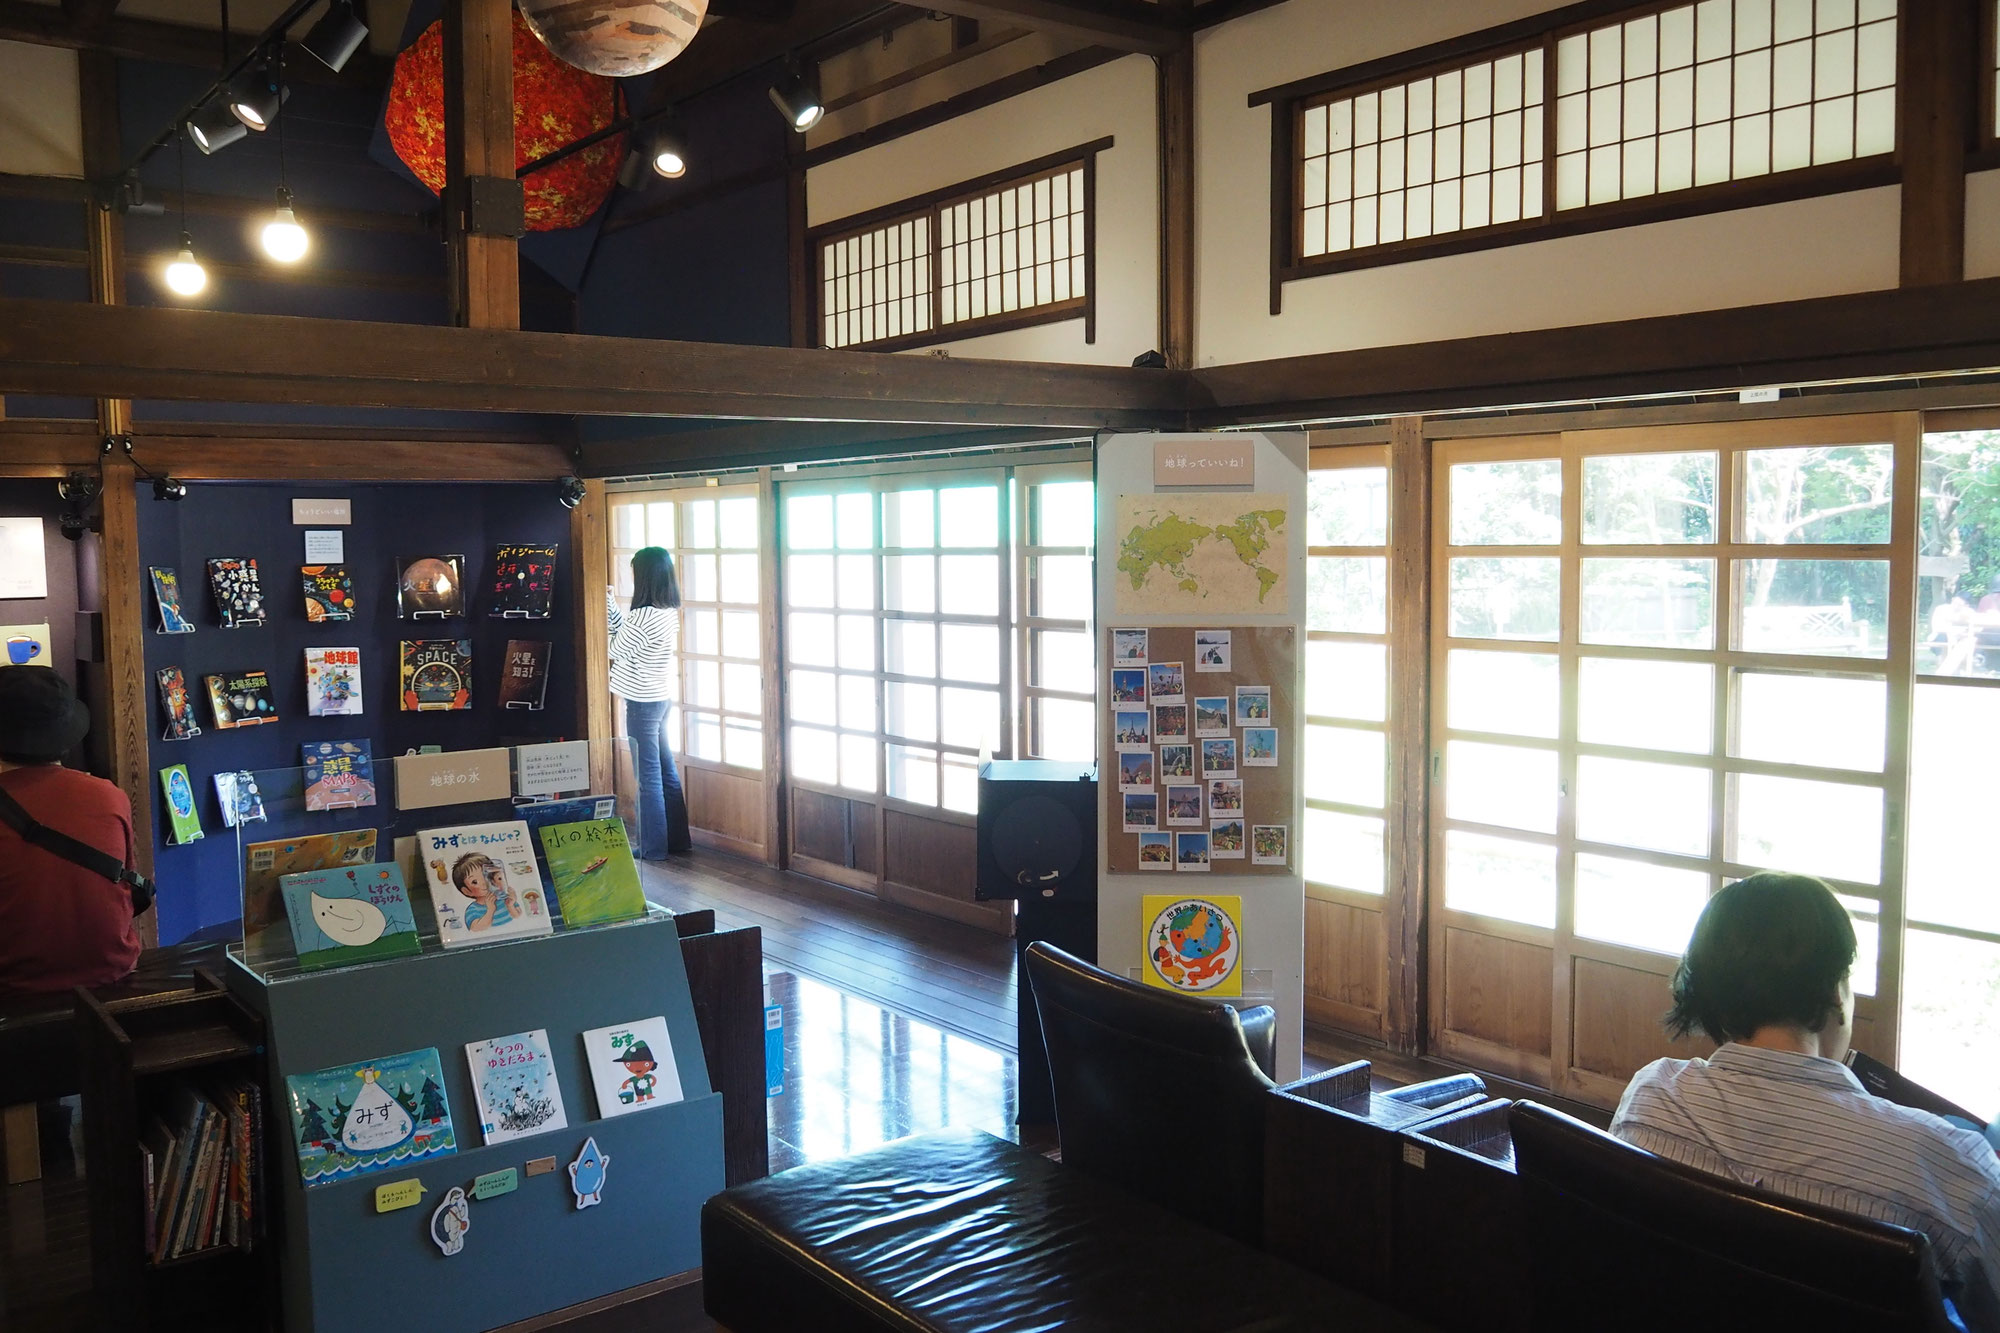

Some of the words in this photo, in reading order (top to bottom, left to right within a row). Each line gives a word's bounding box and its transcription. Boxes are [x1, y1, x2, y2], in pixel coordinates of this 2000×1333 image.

[1164, 457, 1244, 468] 地球っていいね!
[228, 569, 259, 582] 小惑星
[232, 583, 260, 593] ずかん
[324, 651, 358, 664] 地球館
[417, 651, 458, 665] SPACE
[512, 652, 536, 665] 火星を
[512, 666, 533, 678] 知る!
[229, 676, 268, 691] 太陽系探検
[323, 756, 352, 774] 惑星
[322, 773, 358, 787] MAPS
[430, 772, 480, 787] 地球の水
[432, 833, 477, 850] みずとは
[480, 829, 521, 844] なんじゃ?
[547, 823, 620, 848] 水の絵本
[368, 883, 400, 894] しずくの
[370, 895, 404, 905] ぼうけん
[1166, 904, 1223, 922] 世界のあいさつ
[611, 1033, 635, 1048] みず
[494, 1042, 524, 1055] なつの
[487, 1051, 535, 1068] ゆきだるま
[355, 1099, 394, 1124] みず
